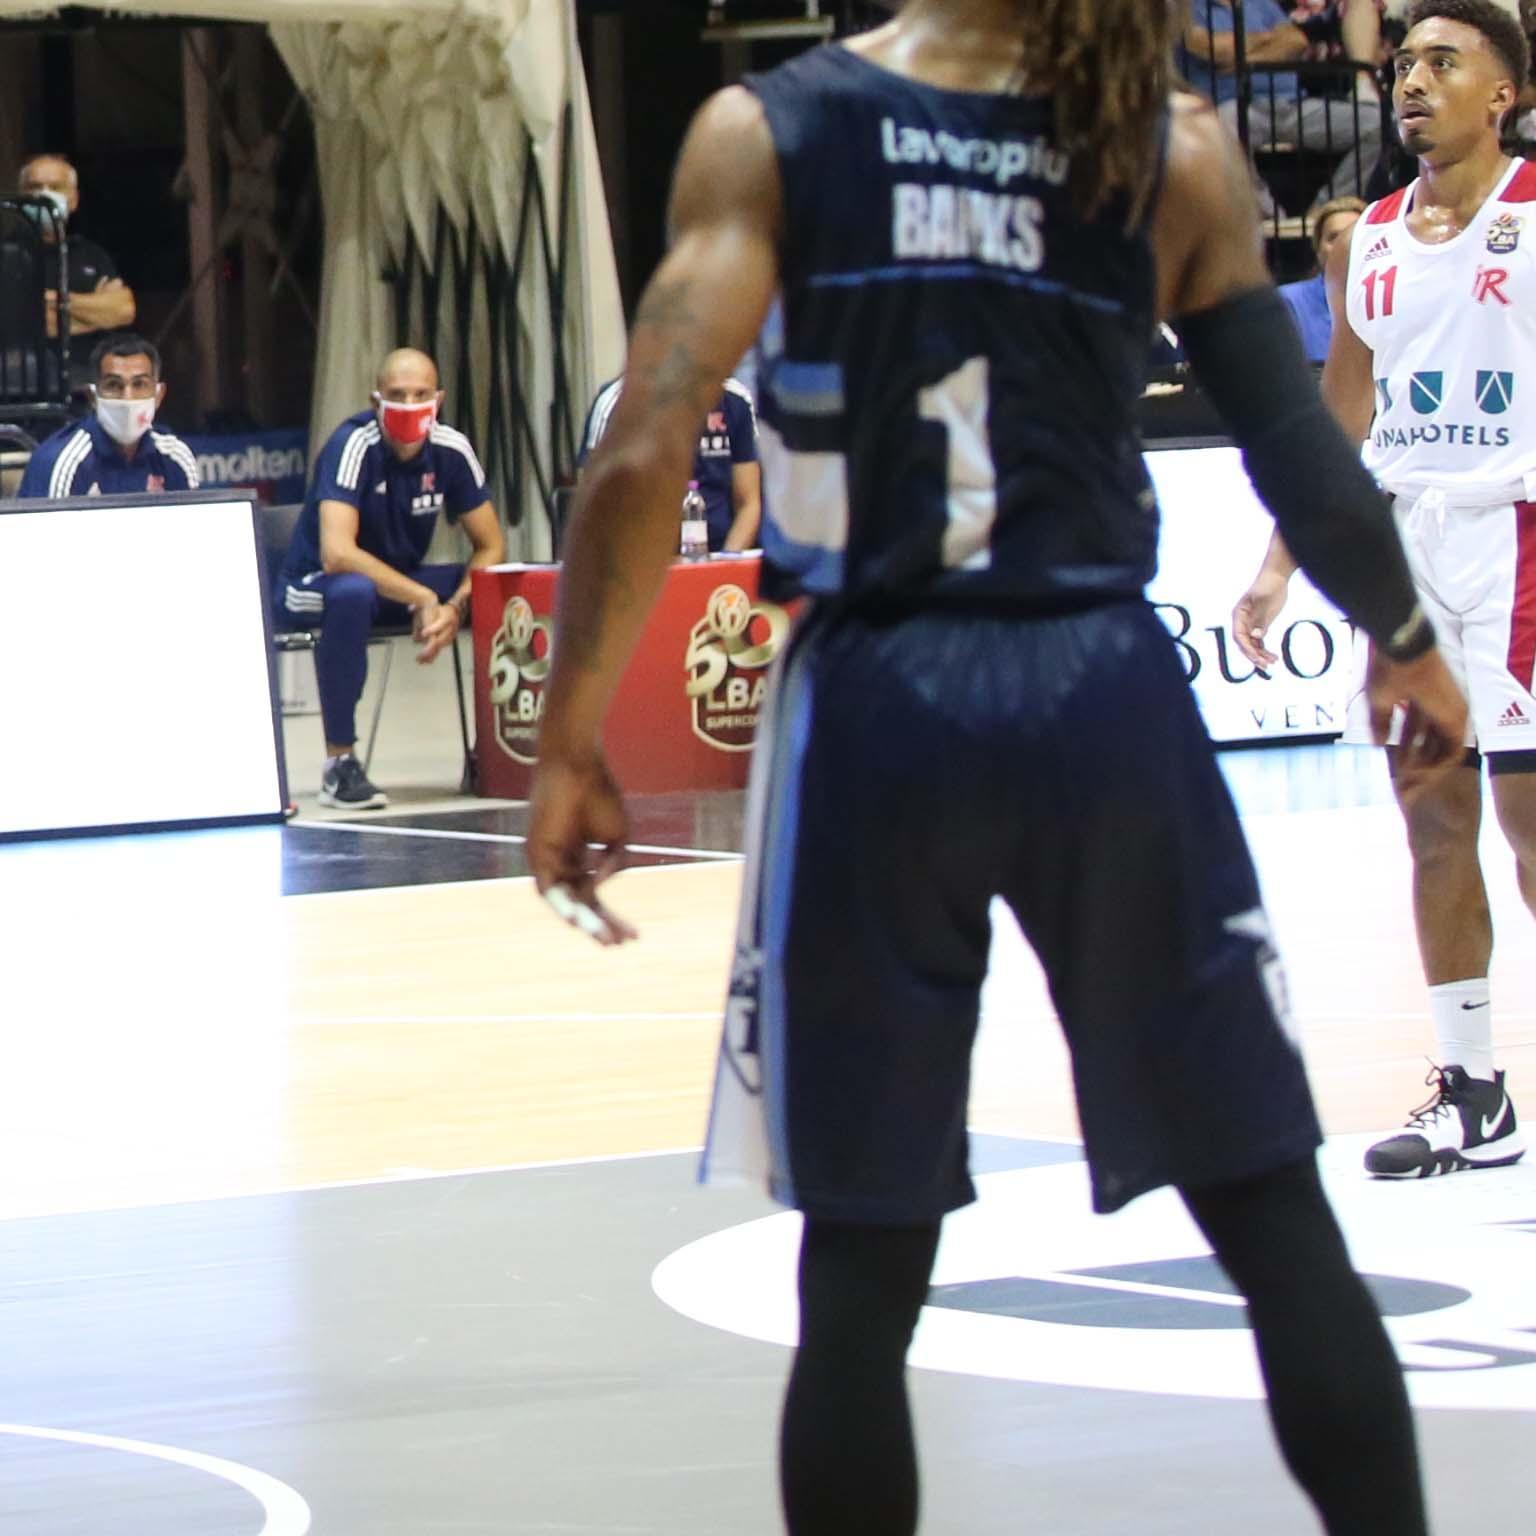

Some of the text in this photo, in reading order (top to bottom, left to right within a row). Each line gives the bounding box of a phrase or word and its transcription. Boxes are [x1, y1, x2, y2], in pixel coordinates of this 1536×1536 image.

[1361, 265, 1398, 322] 11
[197, 445, 306, 484] molten
[917, 355, 998, 571] 1
